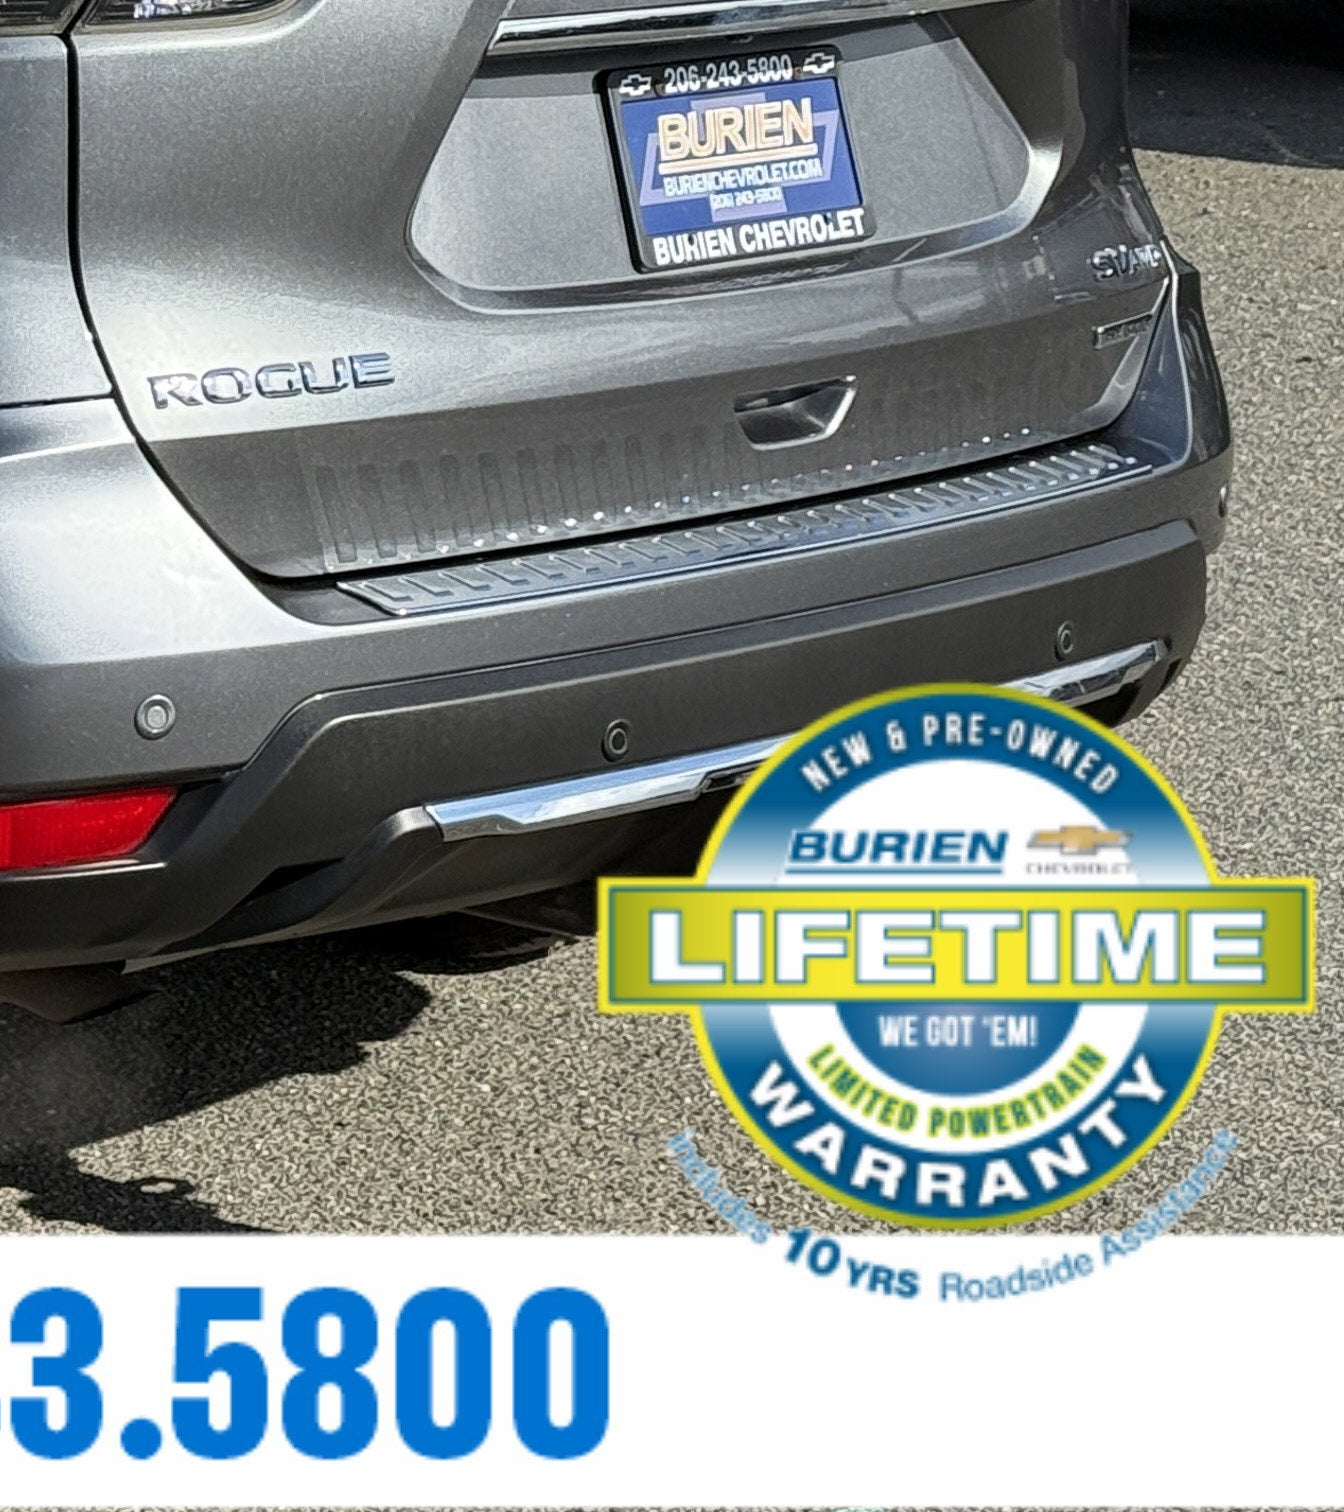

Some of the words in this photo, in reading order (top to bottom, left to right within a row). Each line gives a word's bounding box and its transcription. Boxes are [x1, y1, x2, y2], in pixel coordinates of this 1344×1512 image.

[663, 54, 794, 94] 206-243-5800
[657, 97, 813, 159] BURIEN
[663, 157, 824, 197] BURIENCHEVROLET.COM
[653, 226, 737, 265] BURIEN
[739, 207, 865, 254] CHEVROLET
[146, 351, 396, 410] ROGUE
